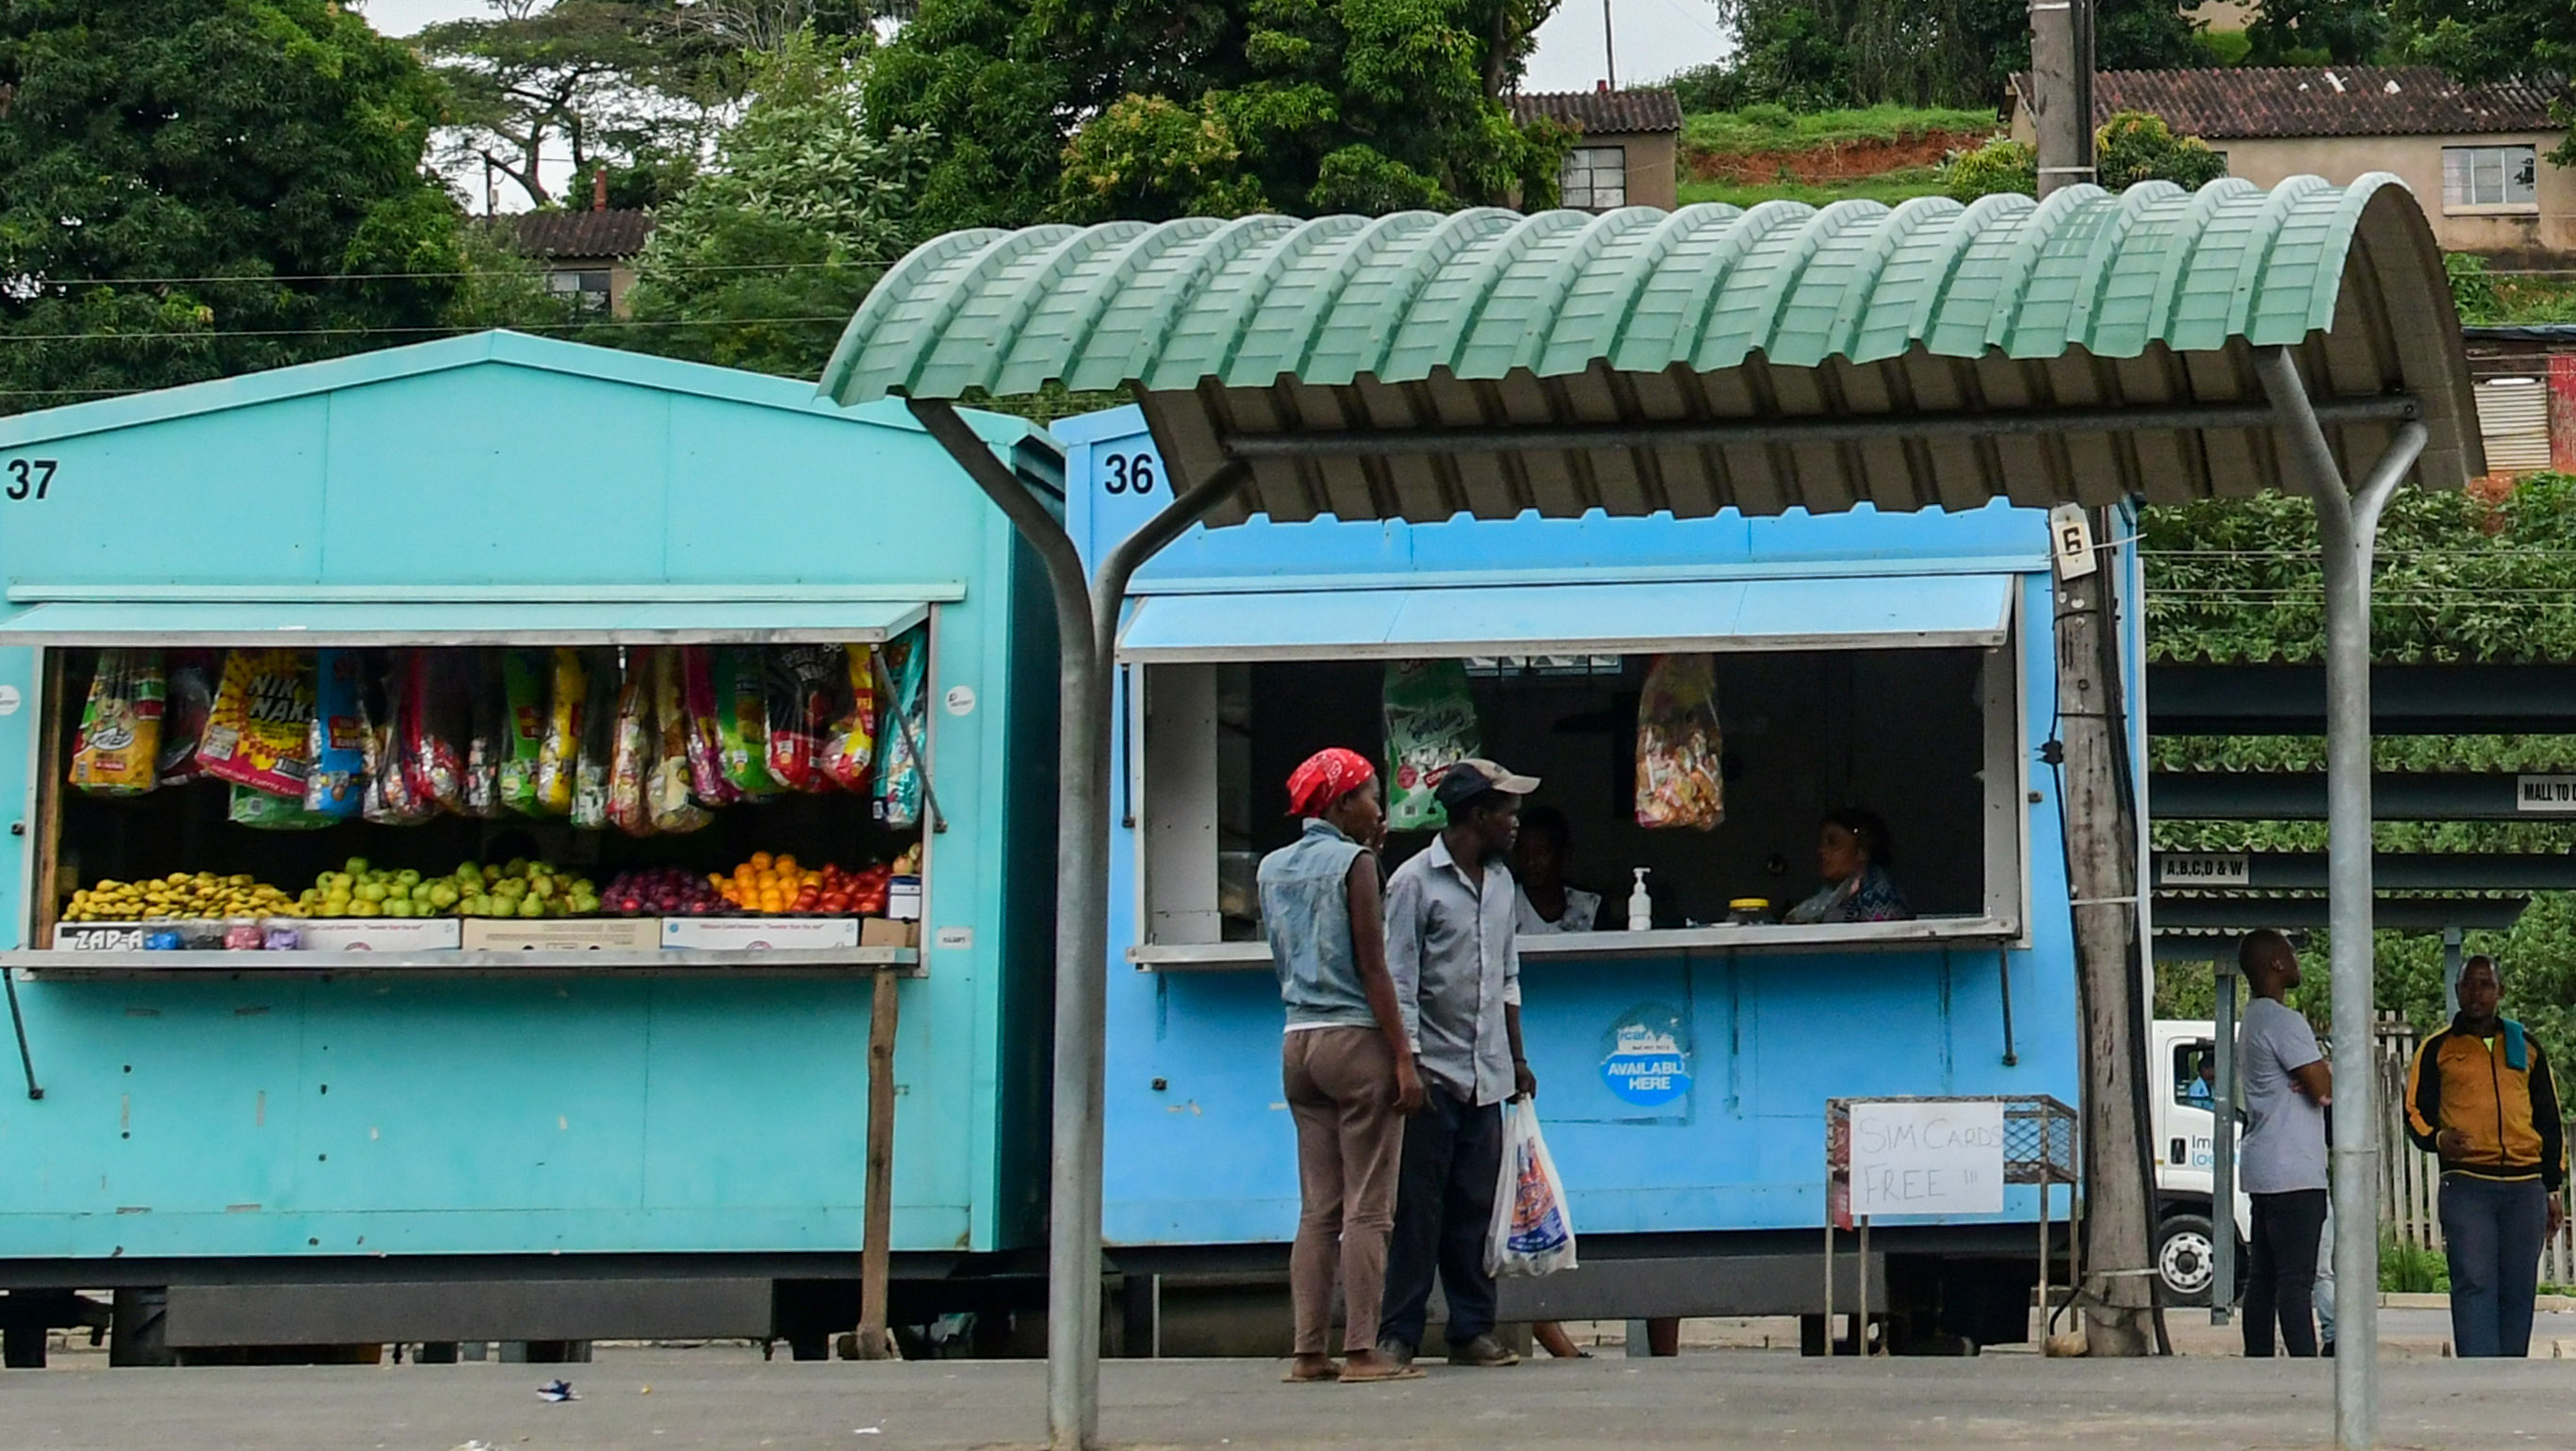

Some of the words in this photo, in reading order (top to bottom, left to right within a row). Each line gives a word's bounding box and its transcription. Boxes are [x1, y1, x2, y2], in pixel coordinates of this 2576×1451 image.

[6, 459, 57, 500] 37
[1104, 453, 1153, 495] 36
[248, 674, 300, 699] NIK
[2524, 783, 2552, 801] MALL
[2556, 783, 2569, 801] TO
[2217, 860, 2226, 875] &
[2230, 860, 2242, 875] W
[1628, 1077, 1671, 1090] HERE
[1859, 1117, 1917, 1154] SIM
[1864, 1162, 1946, 1204] FREE
